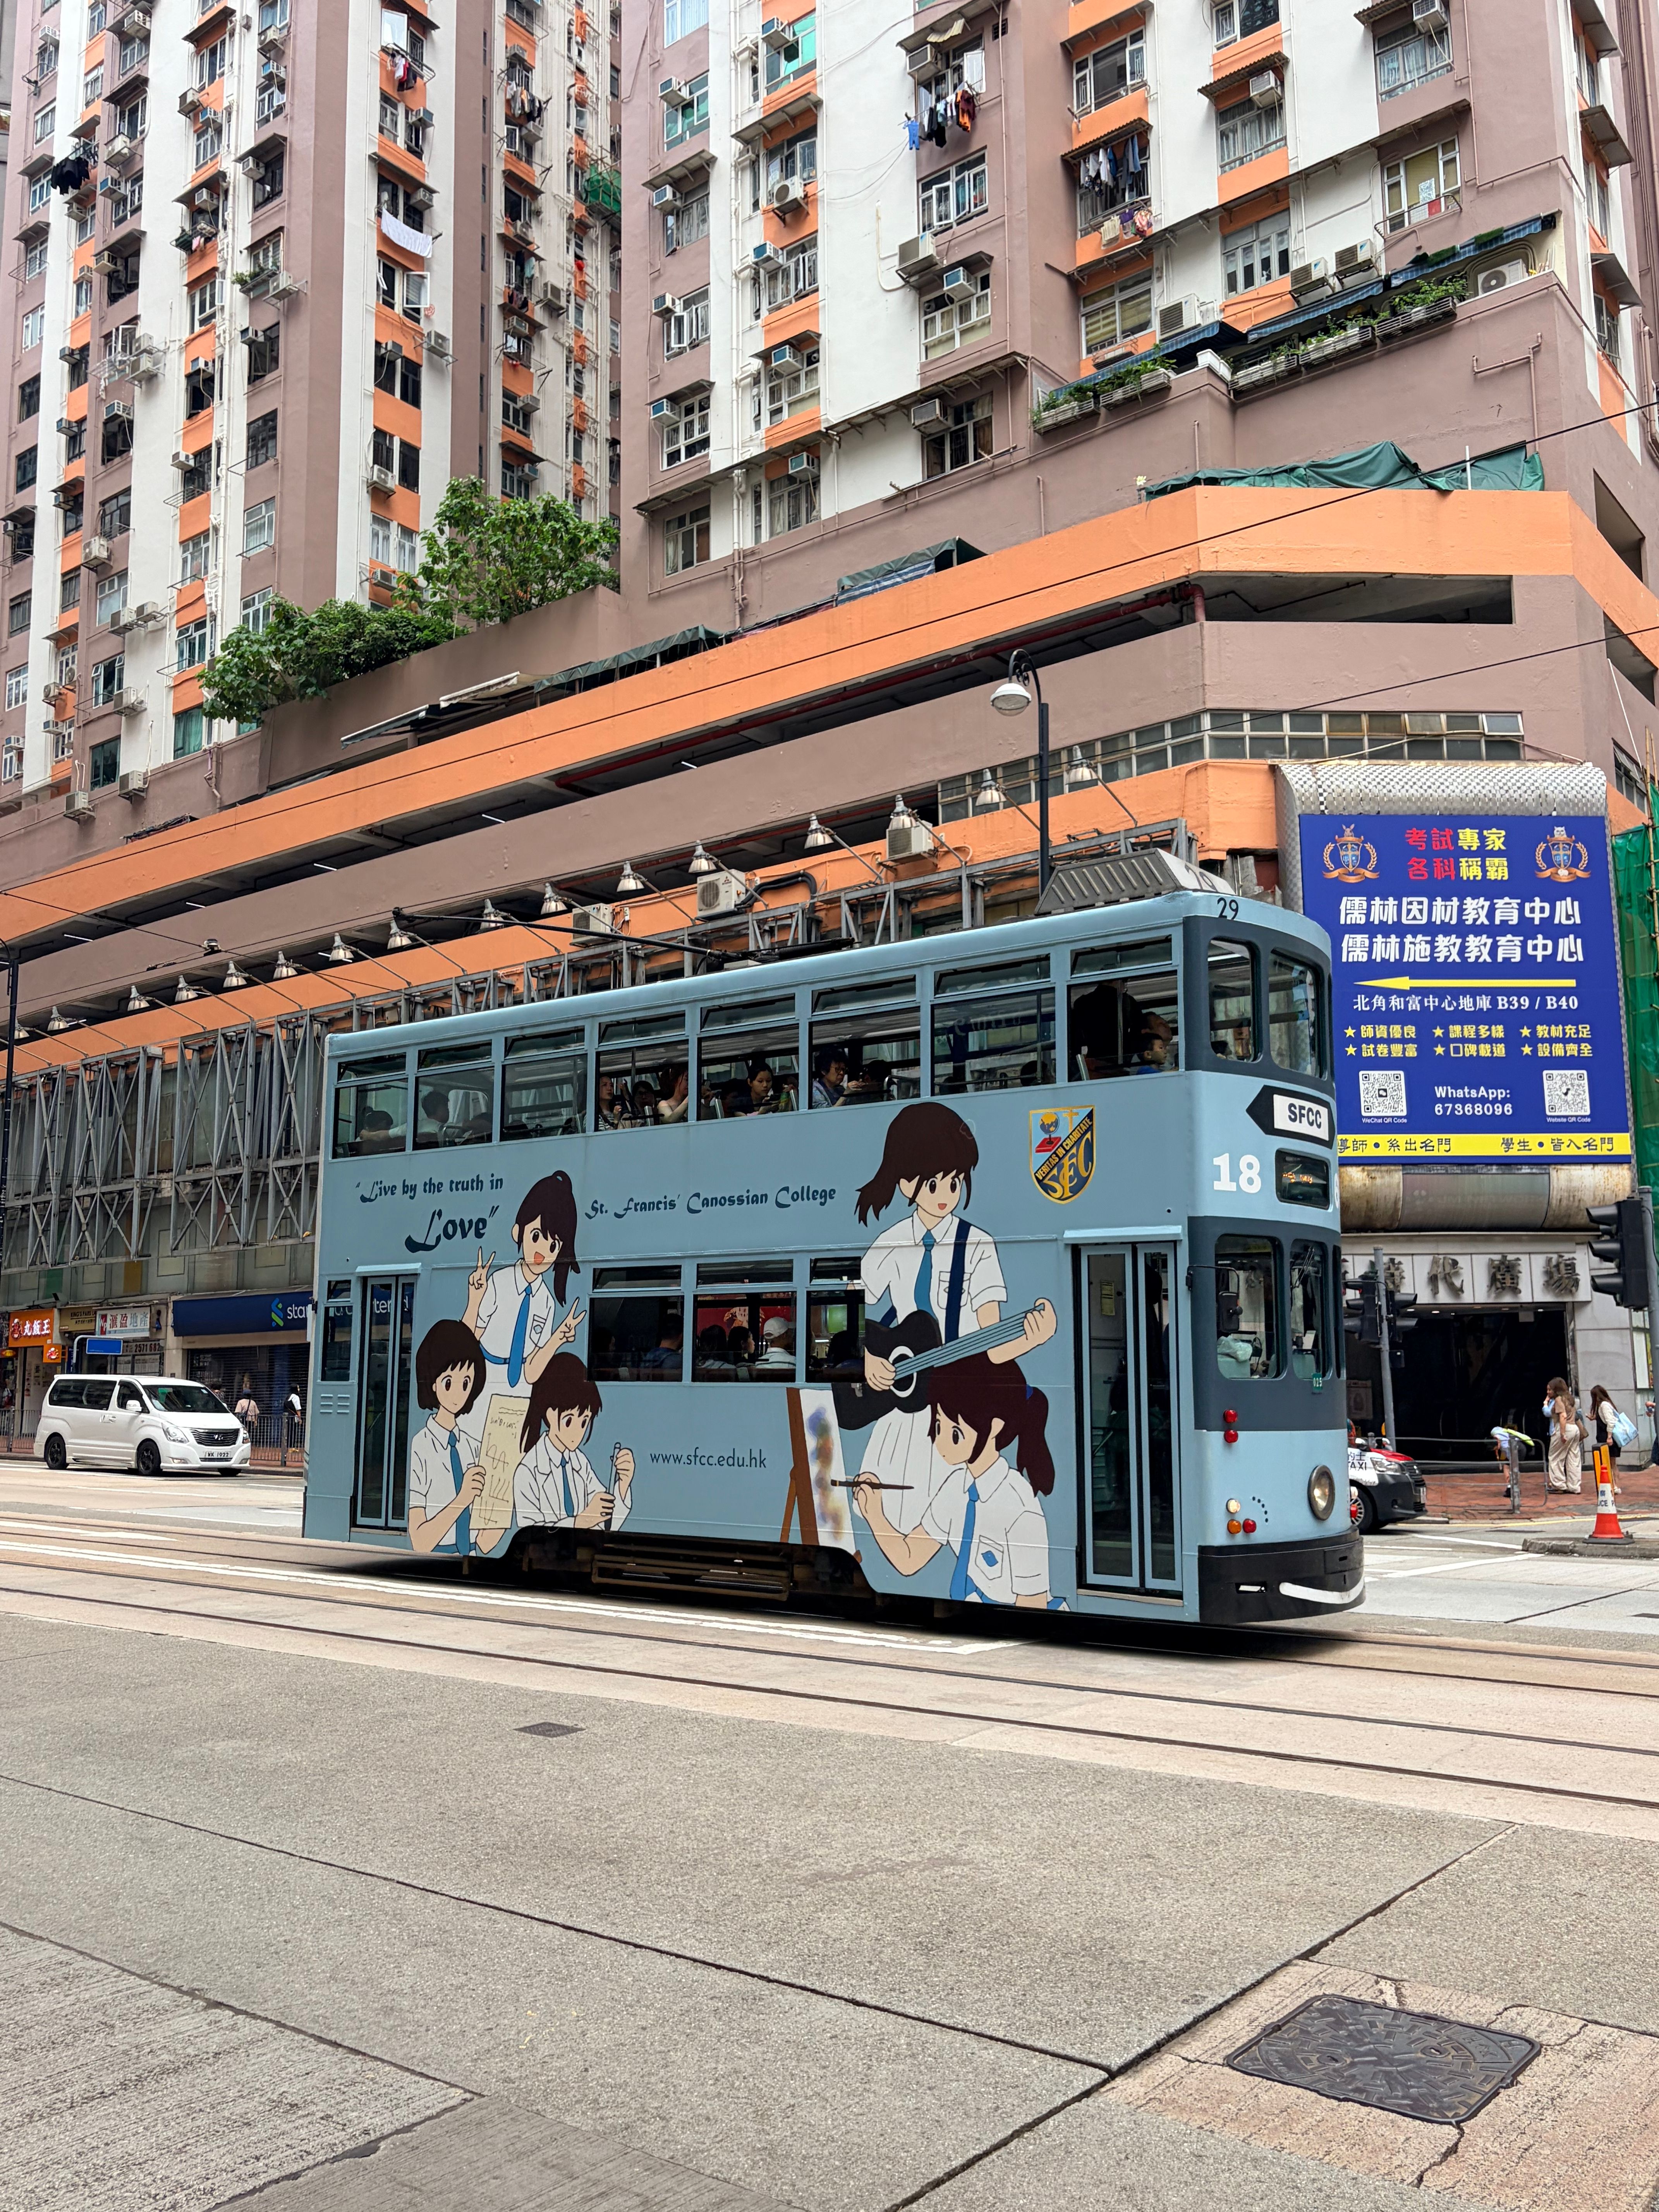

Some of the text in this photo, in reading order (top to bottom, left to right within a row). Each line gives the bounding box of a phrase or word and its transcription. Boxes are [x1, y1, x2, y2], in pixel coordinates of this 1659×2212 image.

[1405, 828, 1506, 850] 考試專家
[1407, 857, 1508, 880] 各科稱霸
[1217, 897, 1239, 920] 29
[1340, 896, 1581, 925] 儒林因材教育中心
[1341, 934, 1584, 963] 儒林施教教育中心
[1353, 994, 1492, 1012] 北角和富中心地庫
[1497, 996, 1529, 1010] B39
[1546, 996, 1578, 1010] B40
[1360, 1025, 1416, 1038] 師資優良
[1449, 1025, 1504, 1038] 課程多樣
[1536, 1024, 1591, 1038] 教材充足
[1362, 1044, 1417, 1057] 試卷豐富
[1450, 1043, 1506, 1057] 口碑載道
[1537, 1043, 1593, 1057] 設備齊全
[1434, 1086, 1510, 1100] WhatsApp:
[1288, 1103, 1322, 1129] SFCC
[1434, 1103, 1513, 1116] 67368096
[1036, 1116, 1092, 1180] VERITAS IN CHARITATE
[1213, 1153, 1261, 1194] 18
[402, 1178, 417, 1199] by
[423, 1177, 443, 1194] the
[449, 1174, 484, 1192] truth
[490, 1174, 503, 1190] in
[585, 1200, 608, 1219] St.
[687, 1192, 768, 1214] Canossian
[775, 1185, 836, 1209] College
[650, 1447, 766, 1468] www.sfcc.edu.hk
